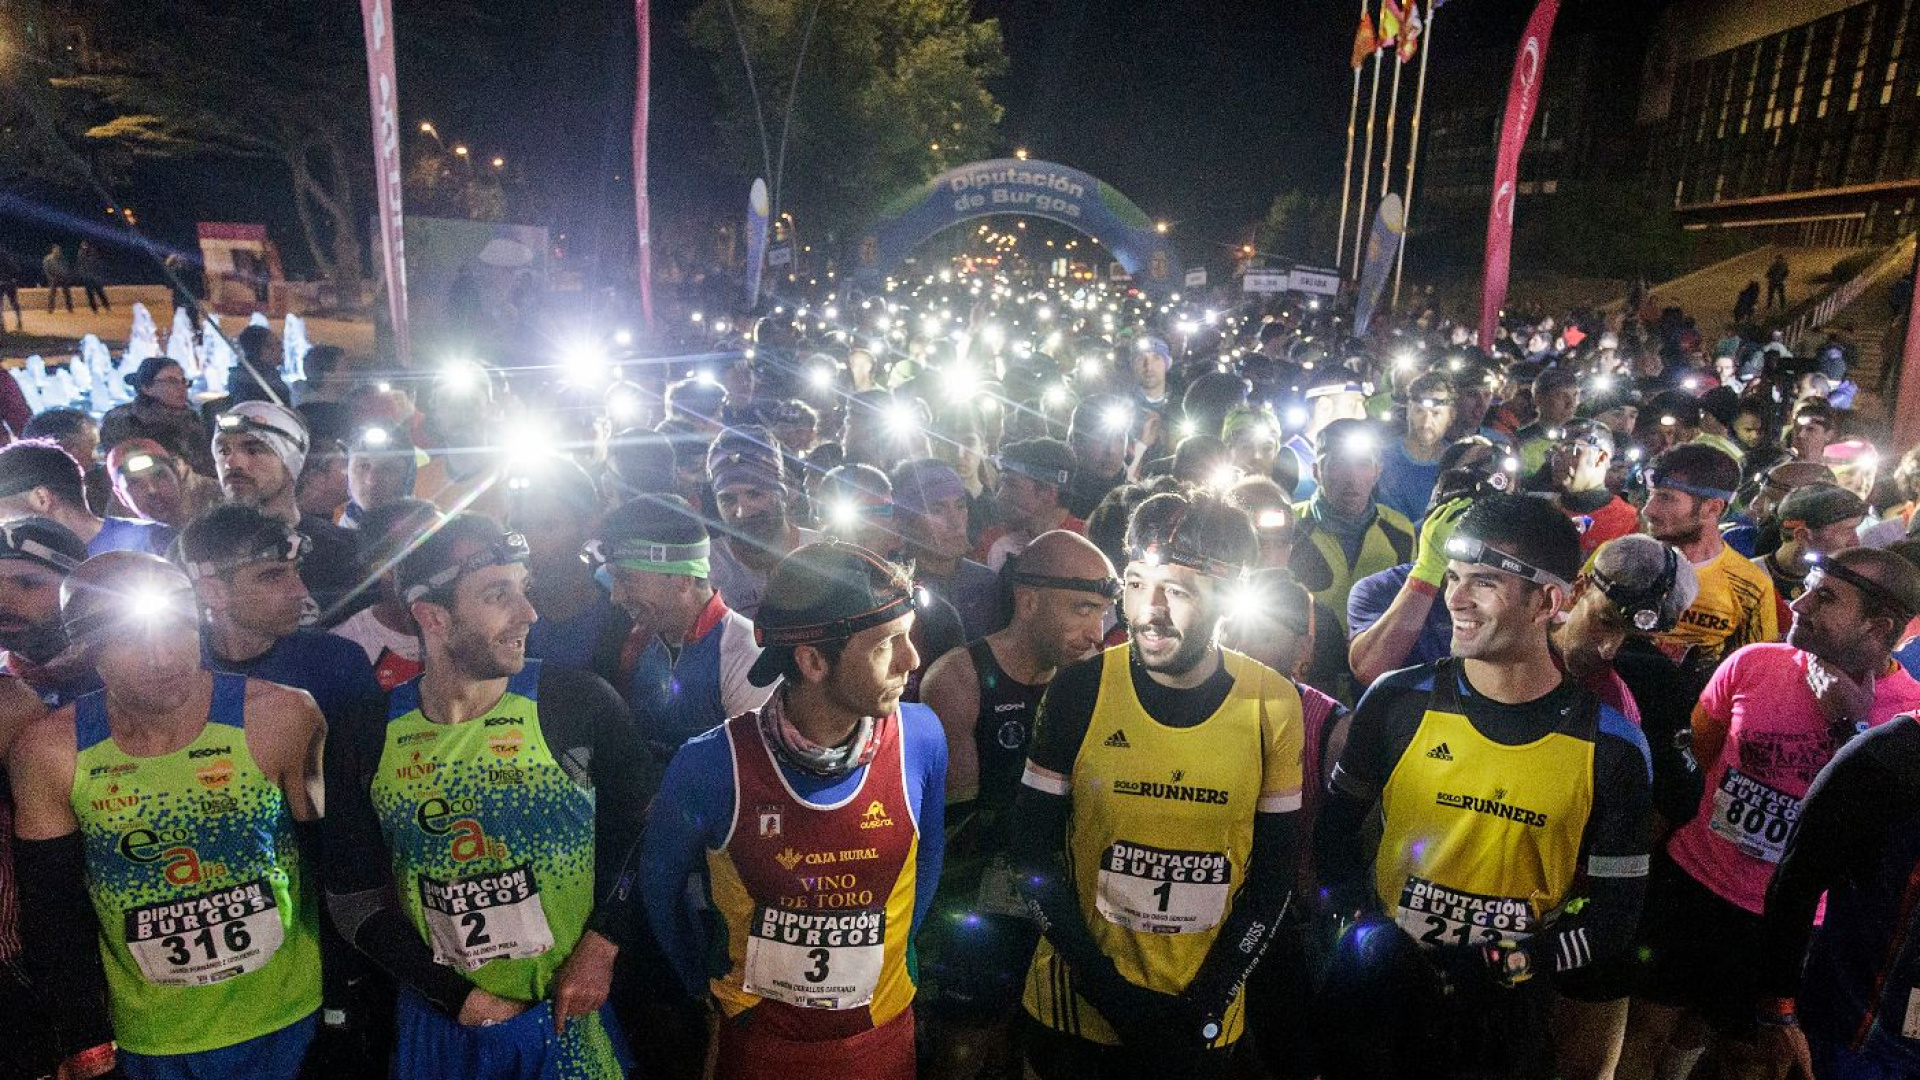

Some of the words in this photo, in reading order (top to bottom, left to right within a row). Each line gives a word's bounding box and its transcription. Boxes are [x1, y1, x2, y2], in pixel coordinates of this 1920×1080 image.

[951, 168, 1084, 198] Diputación
[954, 195, 985, 211] de
[992, 189, 1081, 217] Burgos
[1683, 609, 1730, 630] NERS
[1724, 780, 1800, 820] BURGO
[805, 852, 836, 864] CAJA
[839, 848, 879, 861] RURAL
[1110, 857, 1224, 883] BURGOS
[1113, 843, 1225, 869] DIPUTACIÓN
[424, 869, 526, 900] DIPUTACIÓN
[797, 873, 856, 892] VINO
[1153, 882, 1172, 912] 1
[138, 884, 263, 924] DIPUTACIÓN
[426, 883, 529, 914] BURGOS
[780, 894, 808, 909] DE
[814, 890, 873, 909] TORO
[1410, 895, 1527, 931] BURGOS
[1413, 883, 1527, 917] DIPUTACIÓN
[138, 896, 265, 940] BURGOS
[461, 912, 491, 947] 2
[762, 921, 879, 945] BURGOS
[764, 907, 881, 930] DIPUTACIÓN
[161, 920, 252, 965] 316
[1239, 921, 1266, 953] CROSS
[804, 948, 830, 983] 3
